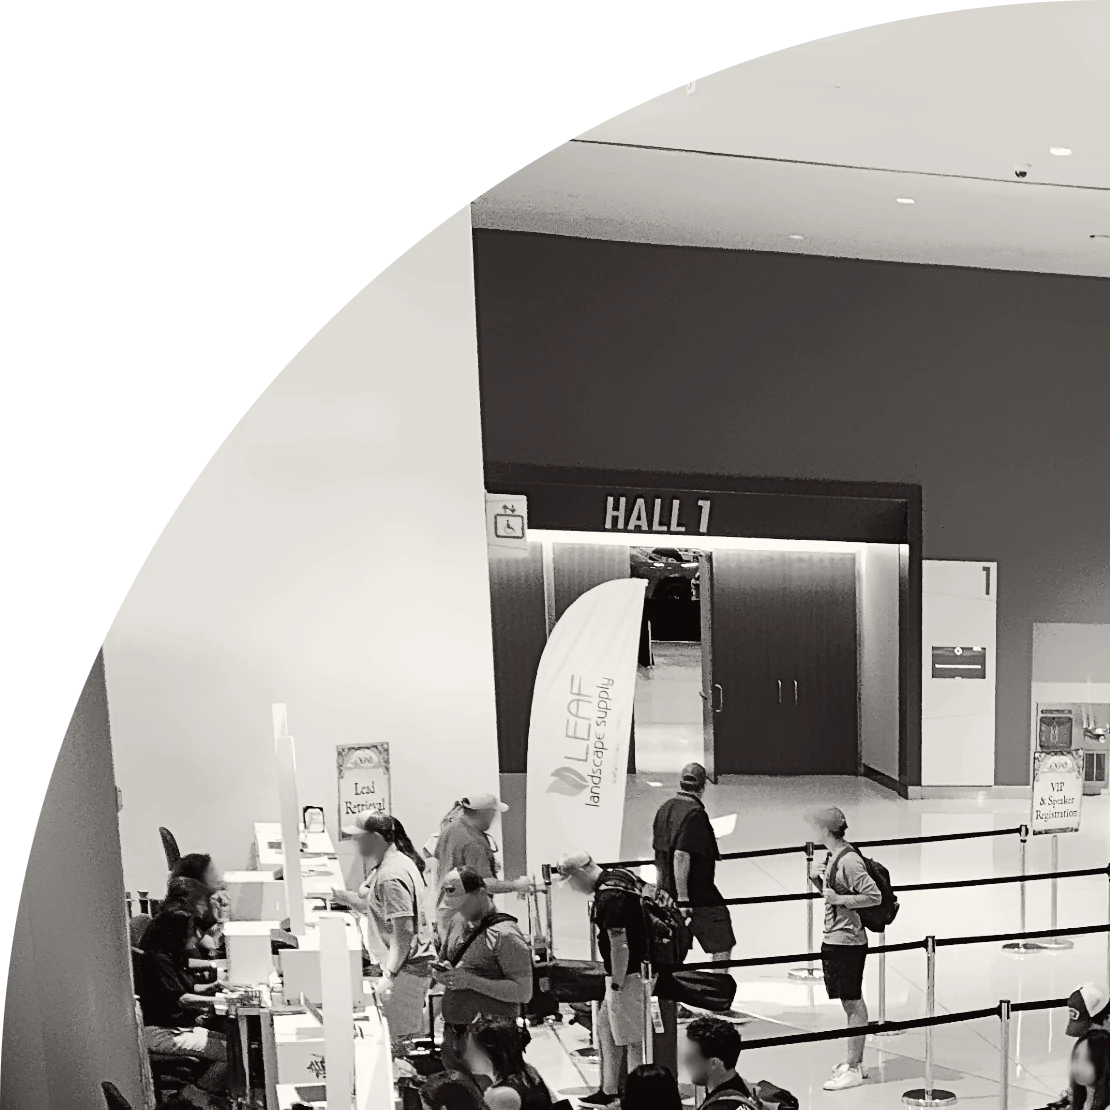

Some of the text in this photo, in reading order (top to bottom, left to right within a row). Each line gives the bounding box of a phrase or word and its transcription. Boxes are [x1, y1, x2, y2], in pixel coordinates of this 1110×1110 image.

[604, 496, 711, 534] HALL 1
[982, 566, 991, 596] 1
[564, 674, 593, 762] LEAF
[585, 676, 614, 808] landscape supply
[354, 781, 376, 796] Lead
[1050, 781, 1065, 792] VIP
[345, 797, 386, 815] Retrieval
[1039, 795, 1075, 809] & Speaker
[1035, 808, 1078, 822] Registration
